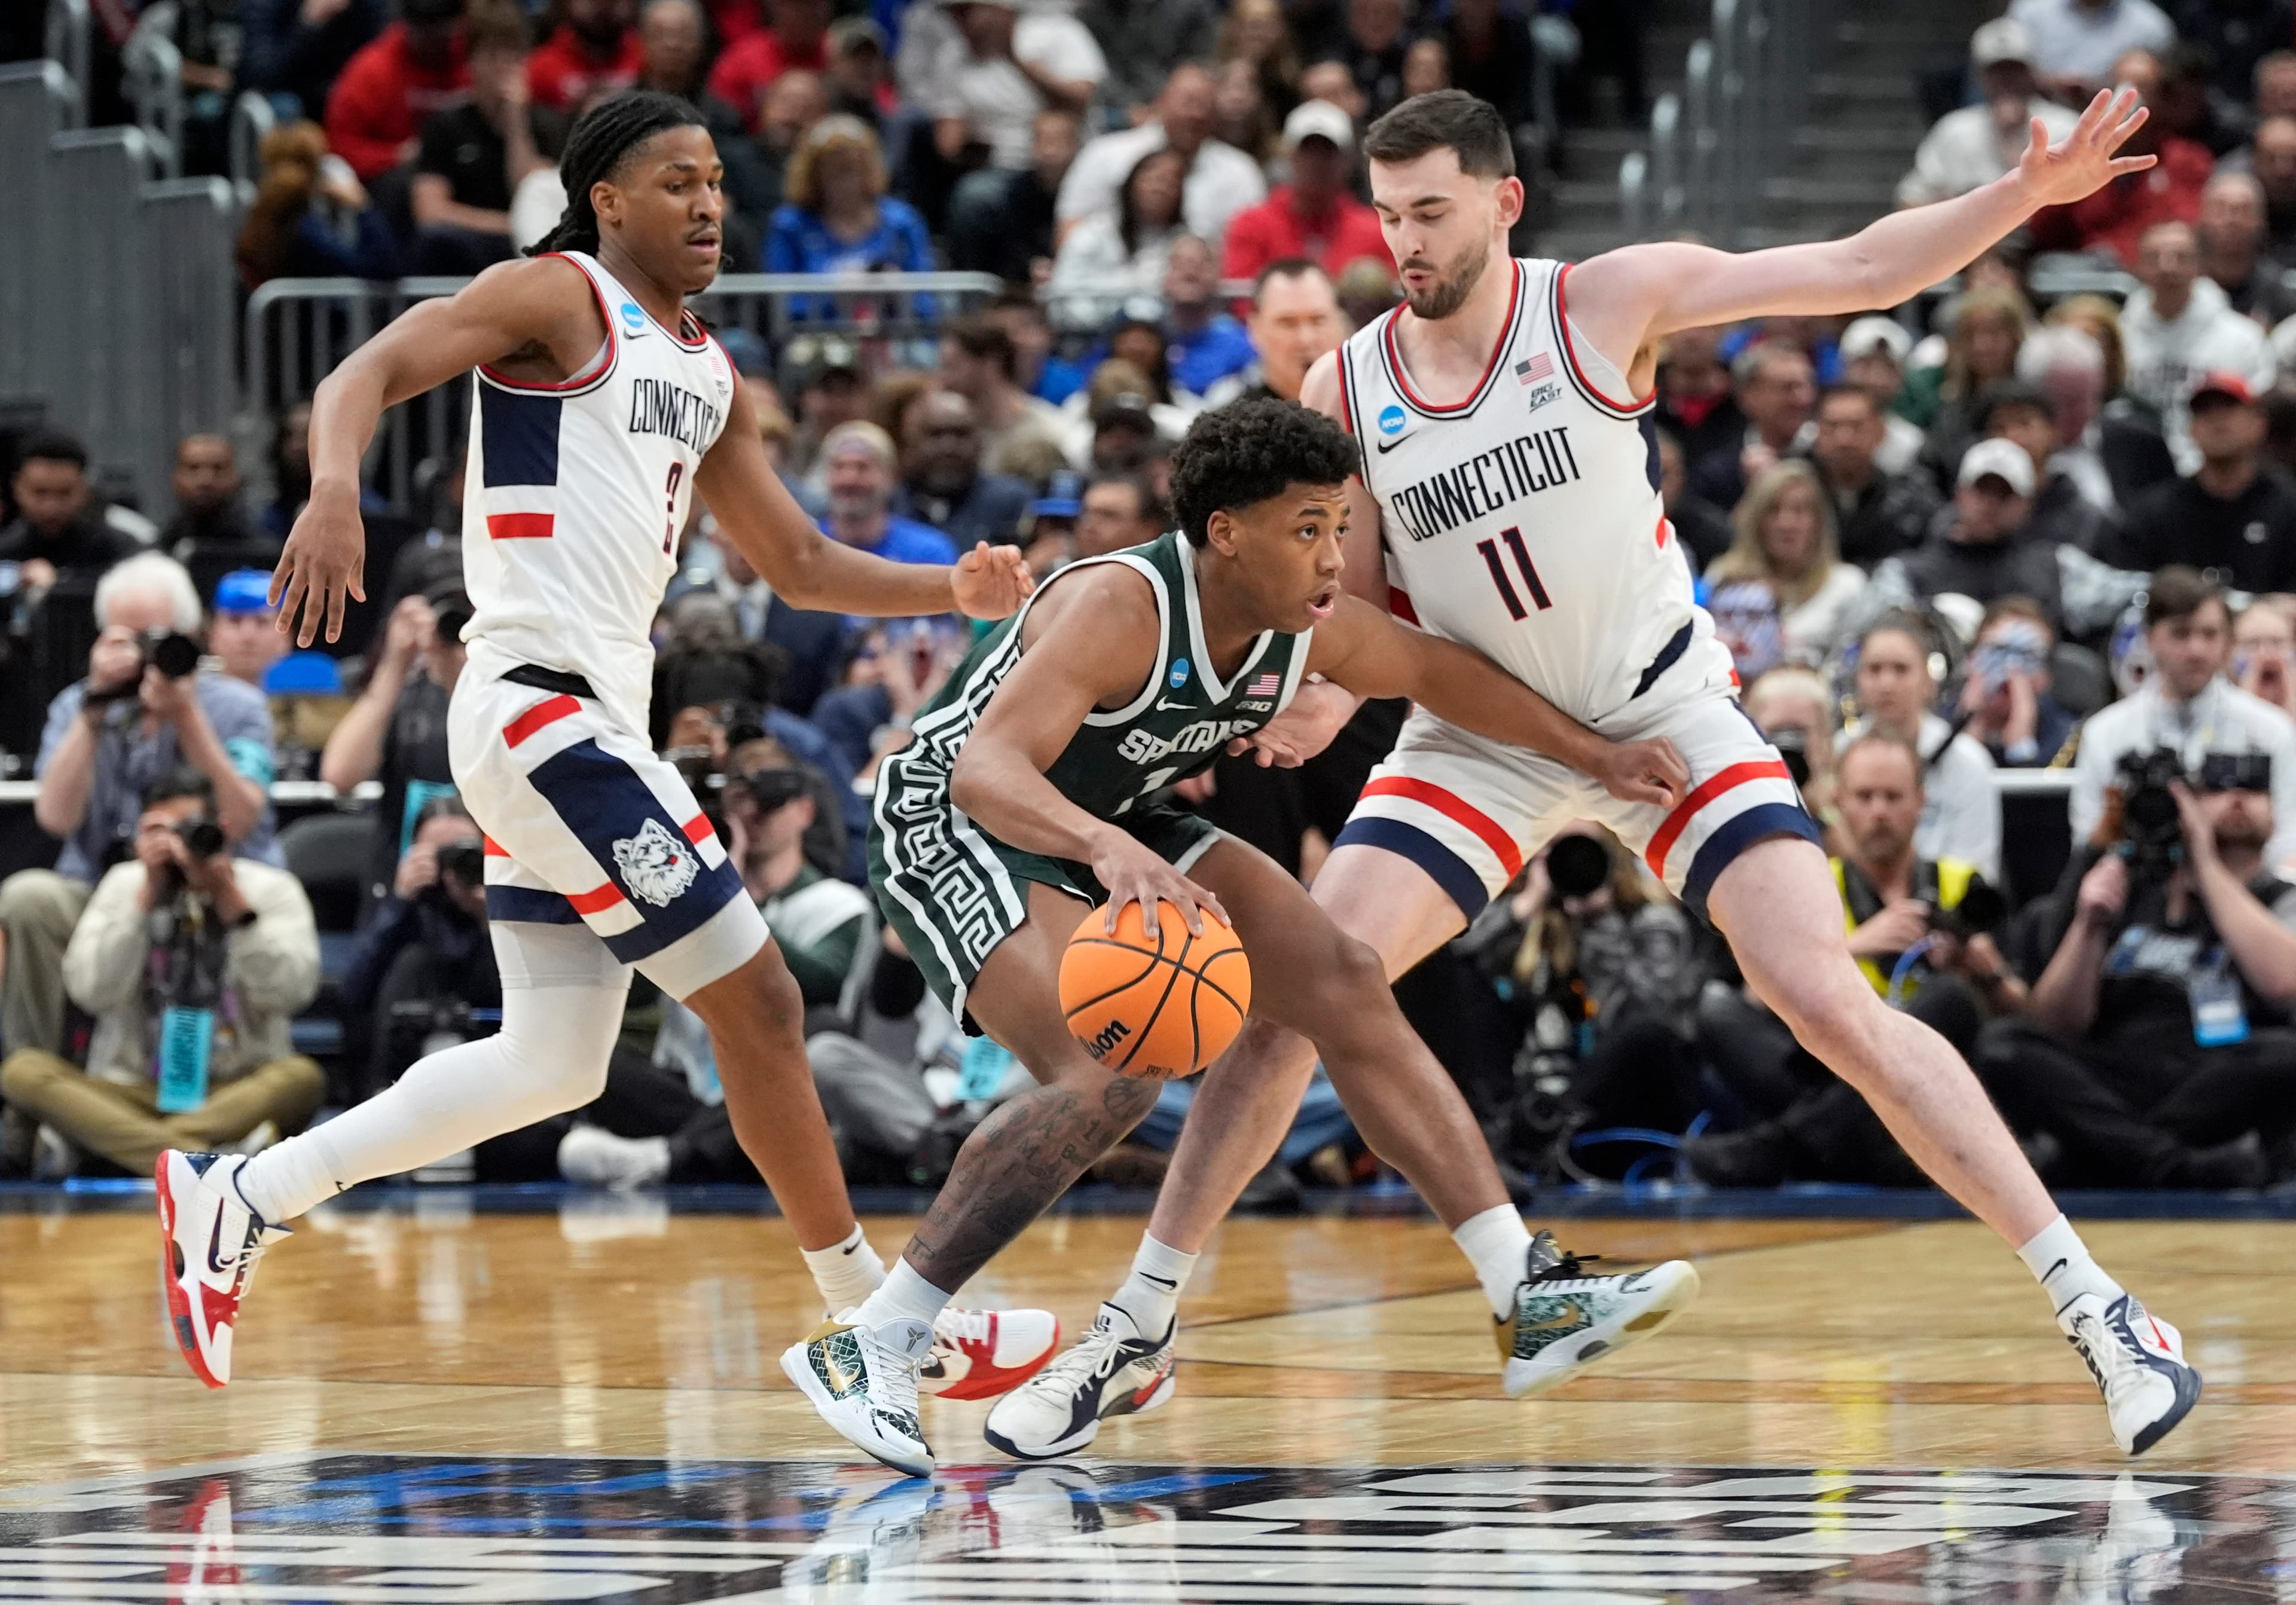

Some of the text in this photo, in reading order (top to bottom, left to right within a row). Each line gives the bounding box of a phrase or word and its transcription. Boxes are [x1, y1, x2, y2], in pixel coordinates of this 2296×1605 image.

[663, 461, 683, 555] 2
[1391, 426, 1581, 542] CONNECTICUT
[1476, 525, 1553, 622] 11
[1079, 1019, 1131, 1062] lson
